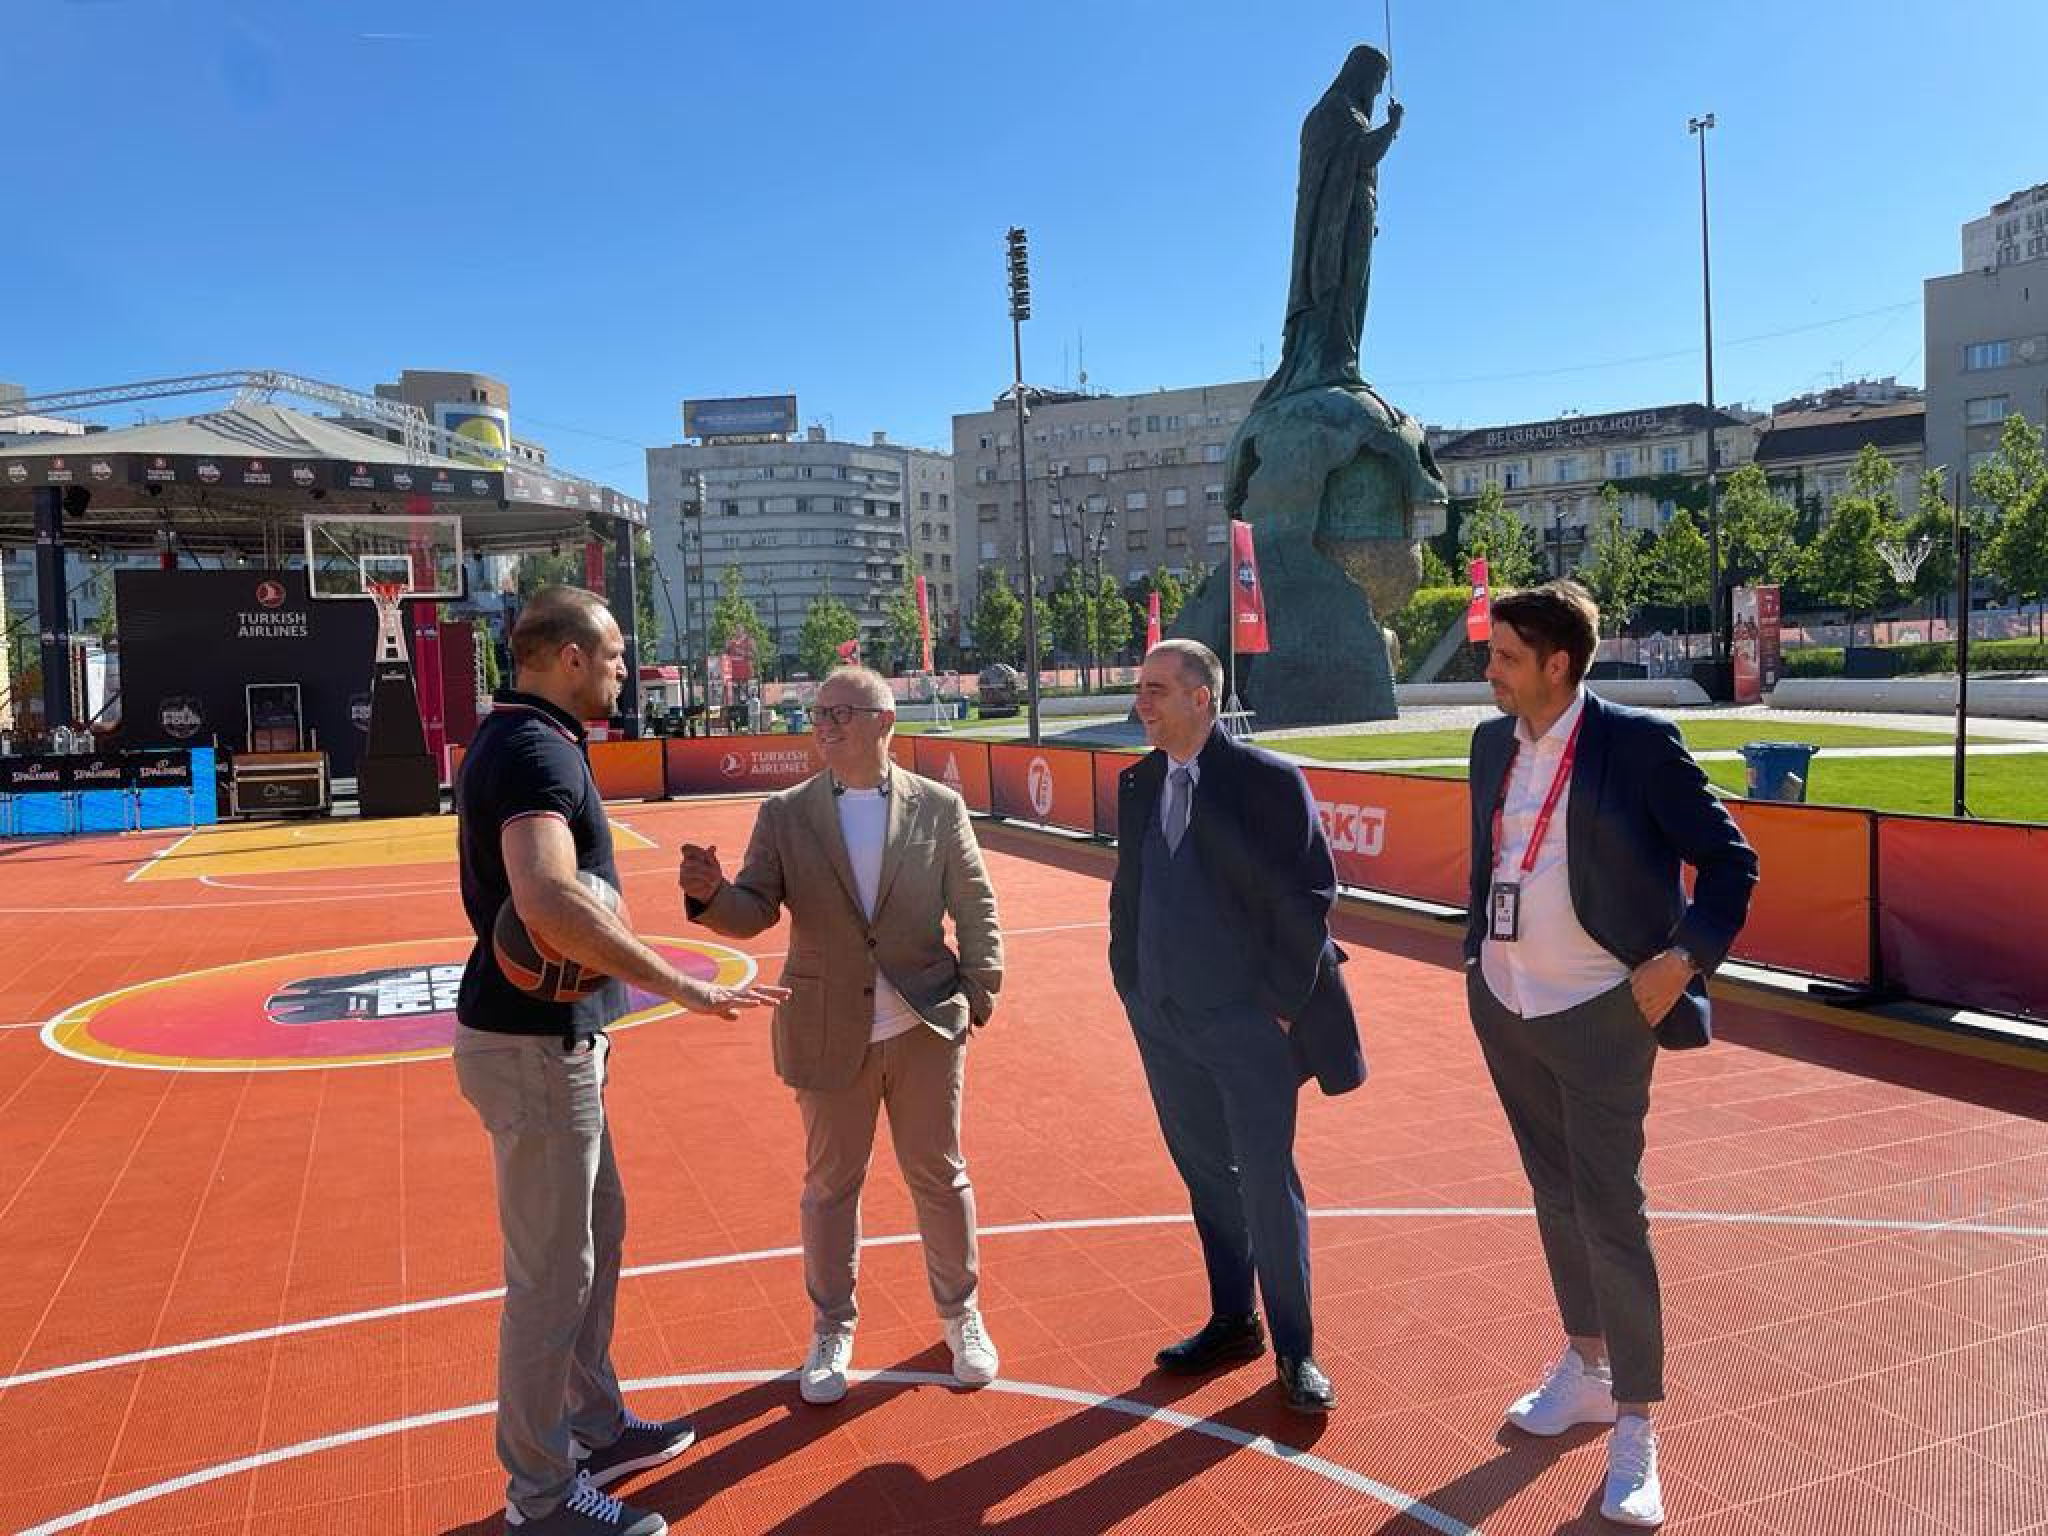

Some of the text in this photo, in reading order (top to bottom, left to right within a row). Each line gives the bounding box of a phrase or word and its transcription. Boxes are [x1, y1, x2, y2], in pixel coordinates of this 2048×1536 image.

[1487, 411, 1658, 447] BELGRADE CITY HOTEL
[238, 612, 307, 625] TURKISH
[238, 625, 308, 637] AIRLINES
[750, 752, 809, 763] TURKISH
[751, 763, 810, 775] AIRLINES
